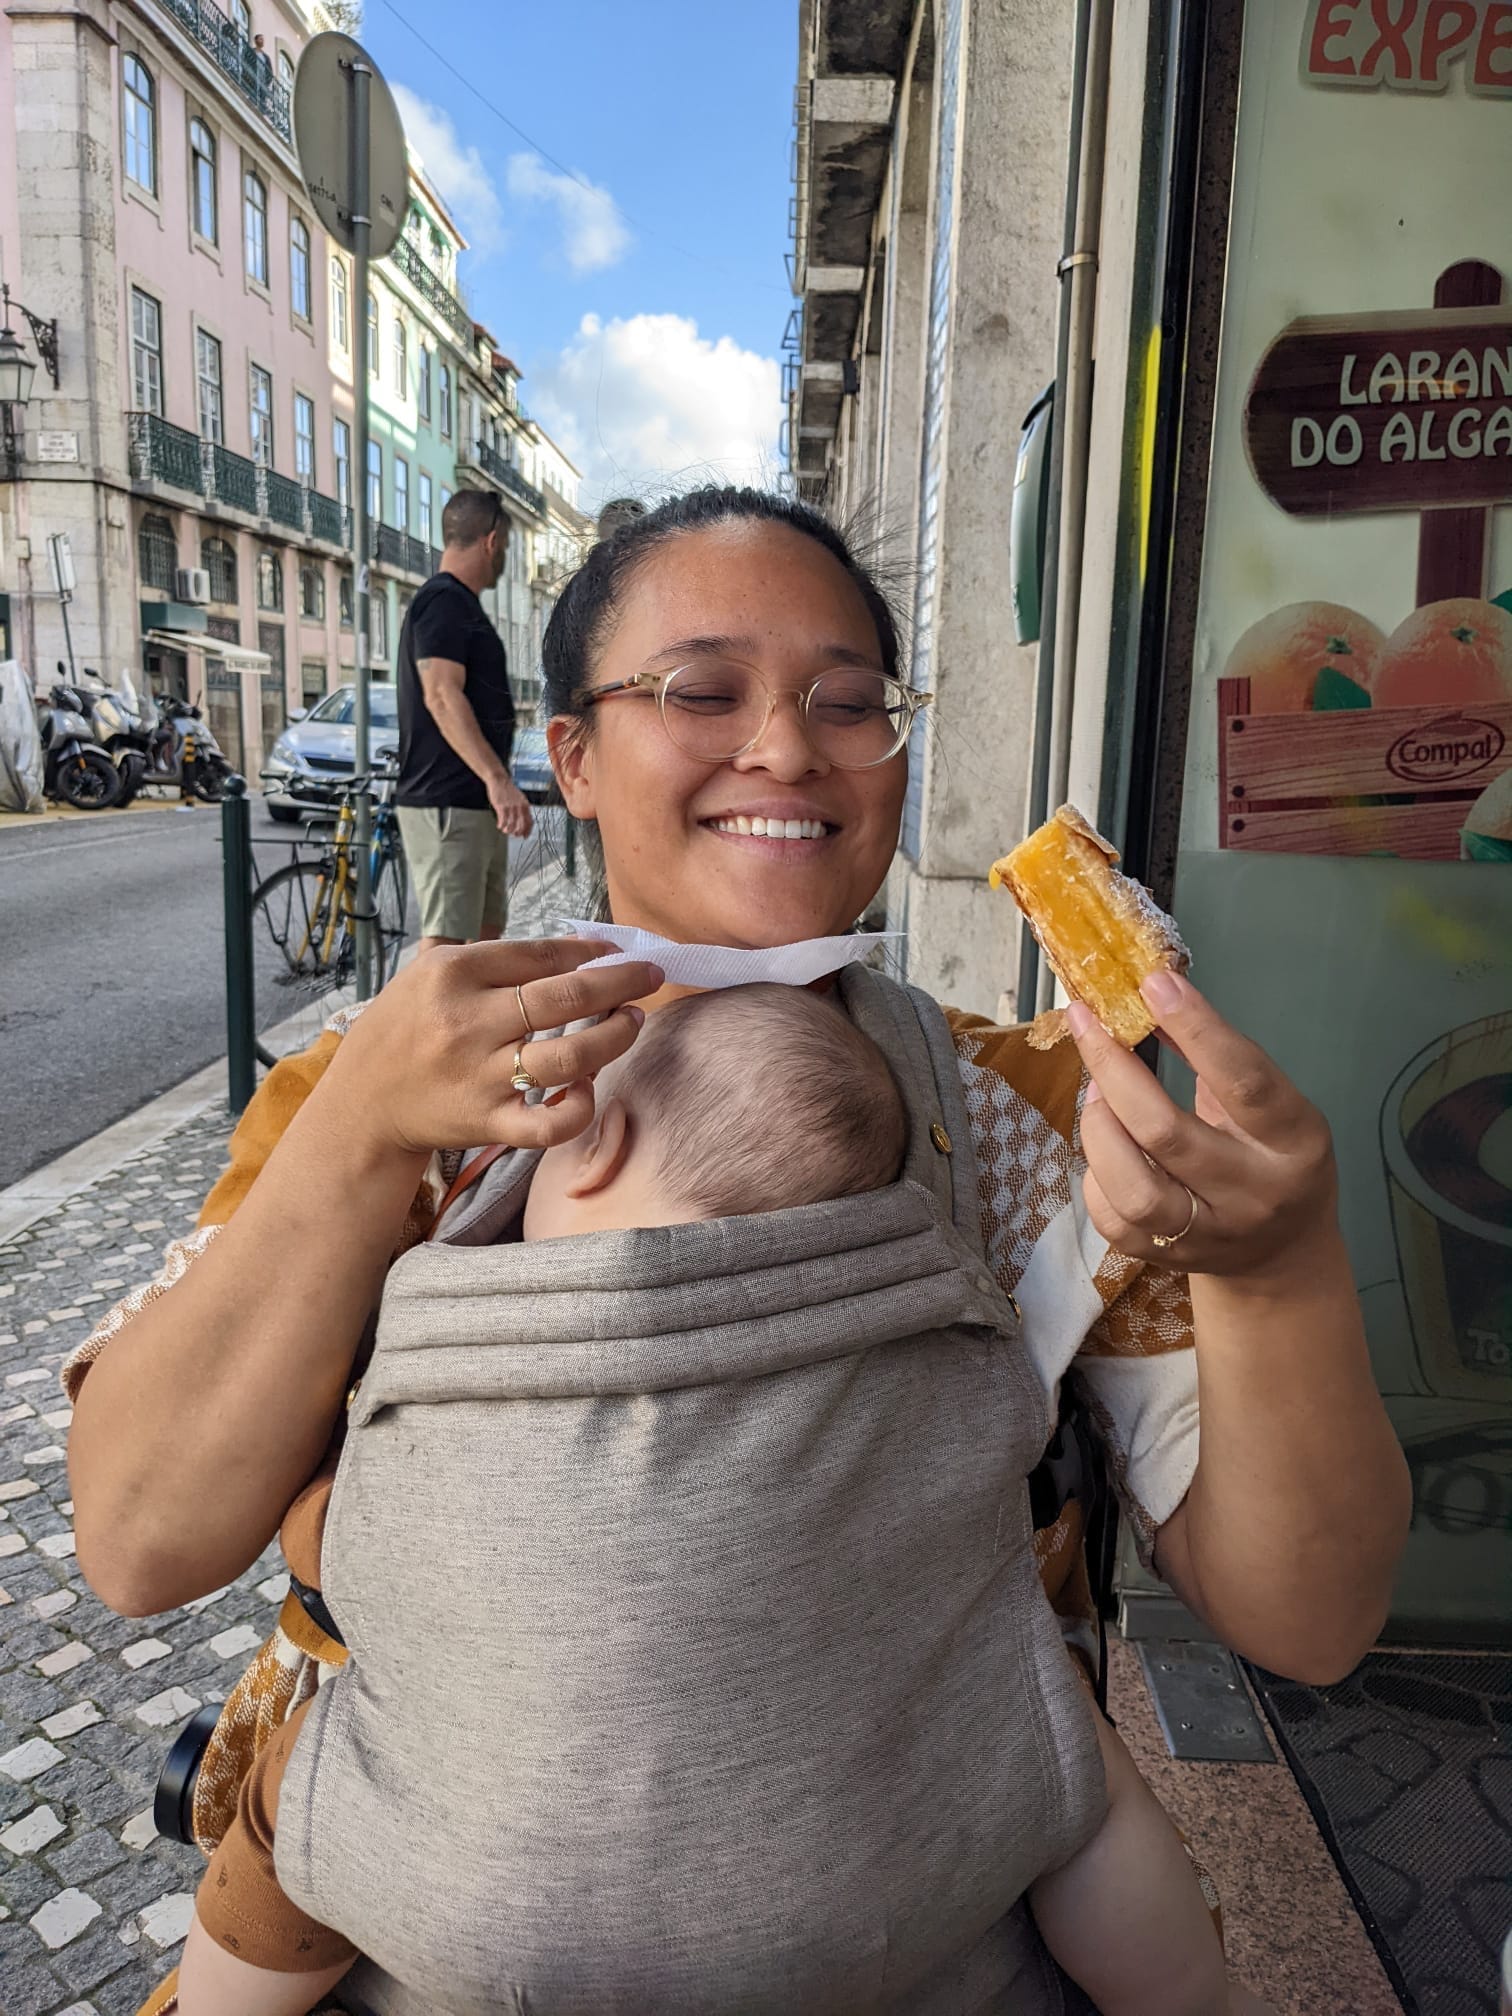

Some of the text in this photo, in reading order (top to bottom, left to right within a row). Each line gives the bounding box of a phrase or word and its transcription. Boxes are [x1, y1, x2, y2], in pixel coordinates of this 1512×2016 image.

[1309, 0, 1512, 84] EXPE
[1340, 347, 1512, 405] LARAN
[1291, 405, 1512, 467] DO ALGA
[1399, 734, 1491, 767] Compal
